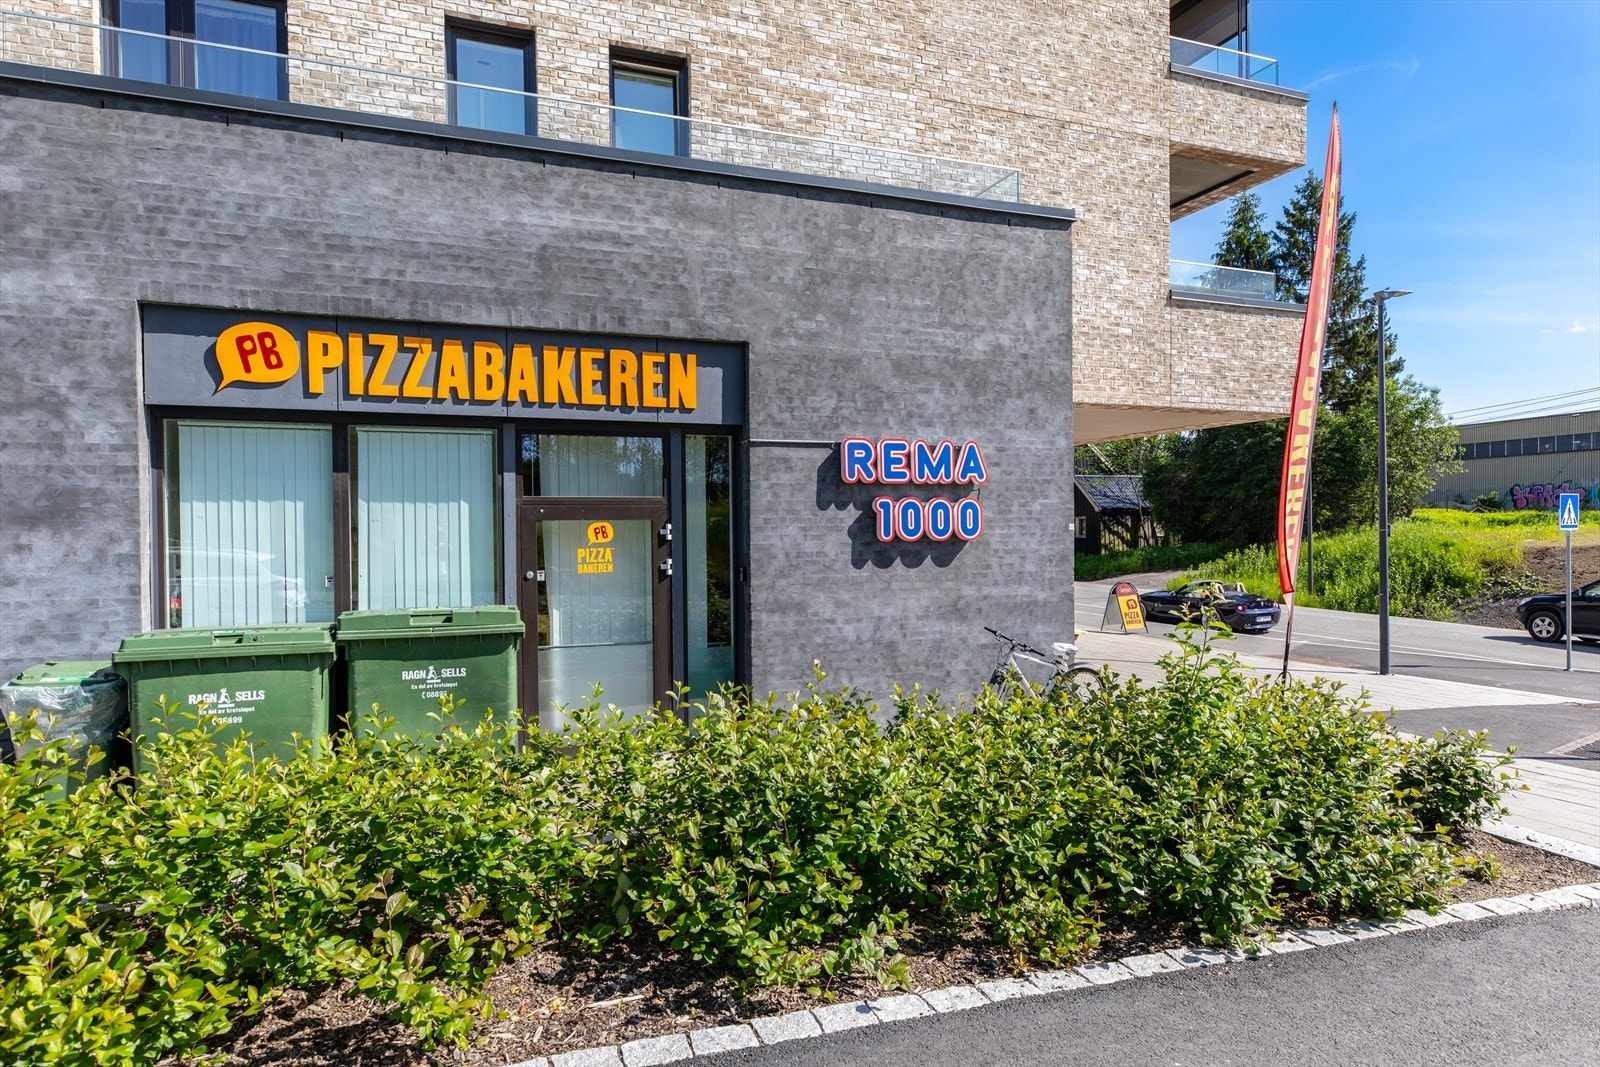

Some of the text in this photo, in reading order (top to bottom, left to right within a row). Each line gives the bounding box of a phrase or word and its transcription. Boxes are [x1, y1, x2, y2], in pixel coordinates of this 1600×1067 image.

[235, 331, 284, 374] PB
[306, 329, 698, 410] PIZZABAKEREN
[841, 437, 989, 485] REMA
[872, 495, 985, 543] 1000
[593, 525, 608, 540] PB
[577, 547, 613, 563] PIZZA
[577, 563, 614, 574] BAKEREN
[402, 668, 466, 680] RAGN SELLS
[188, 690, 265, 705] RAGN SELLS
